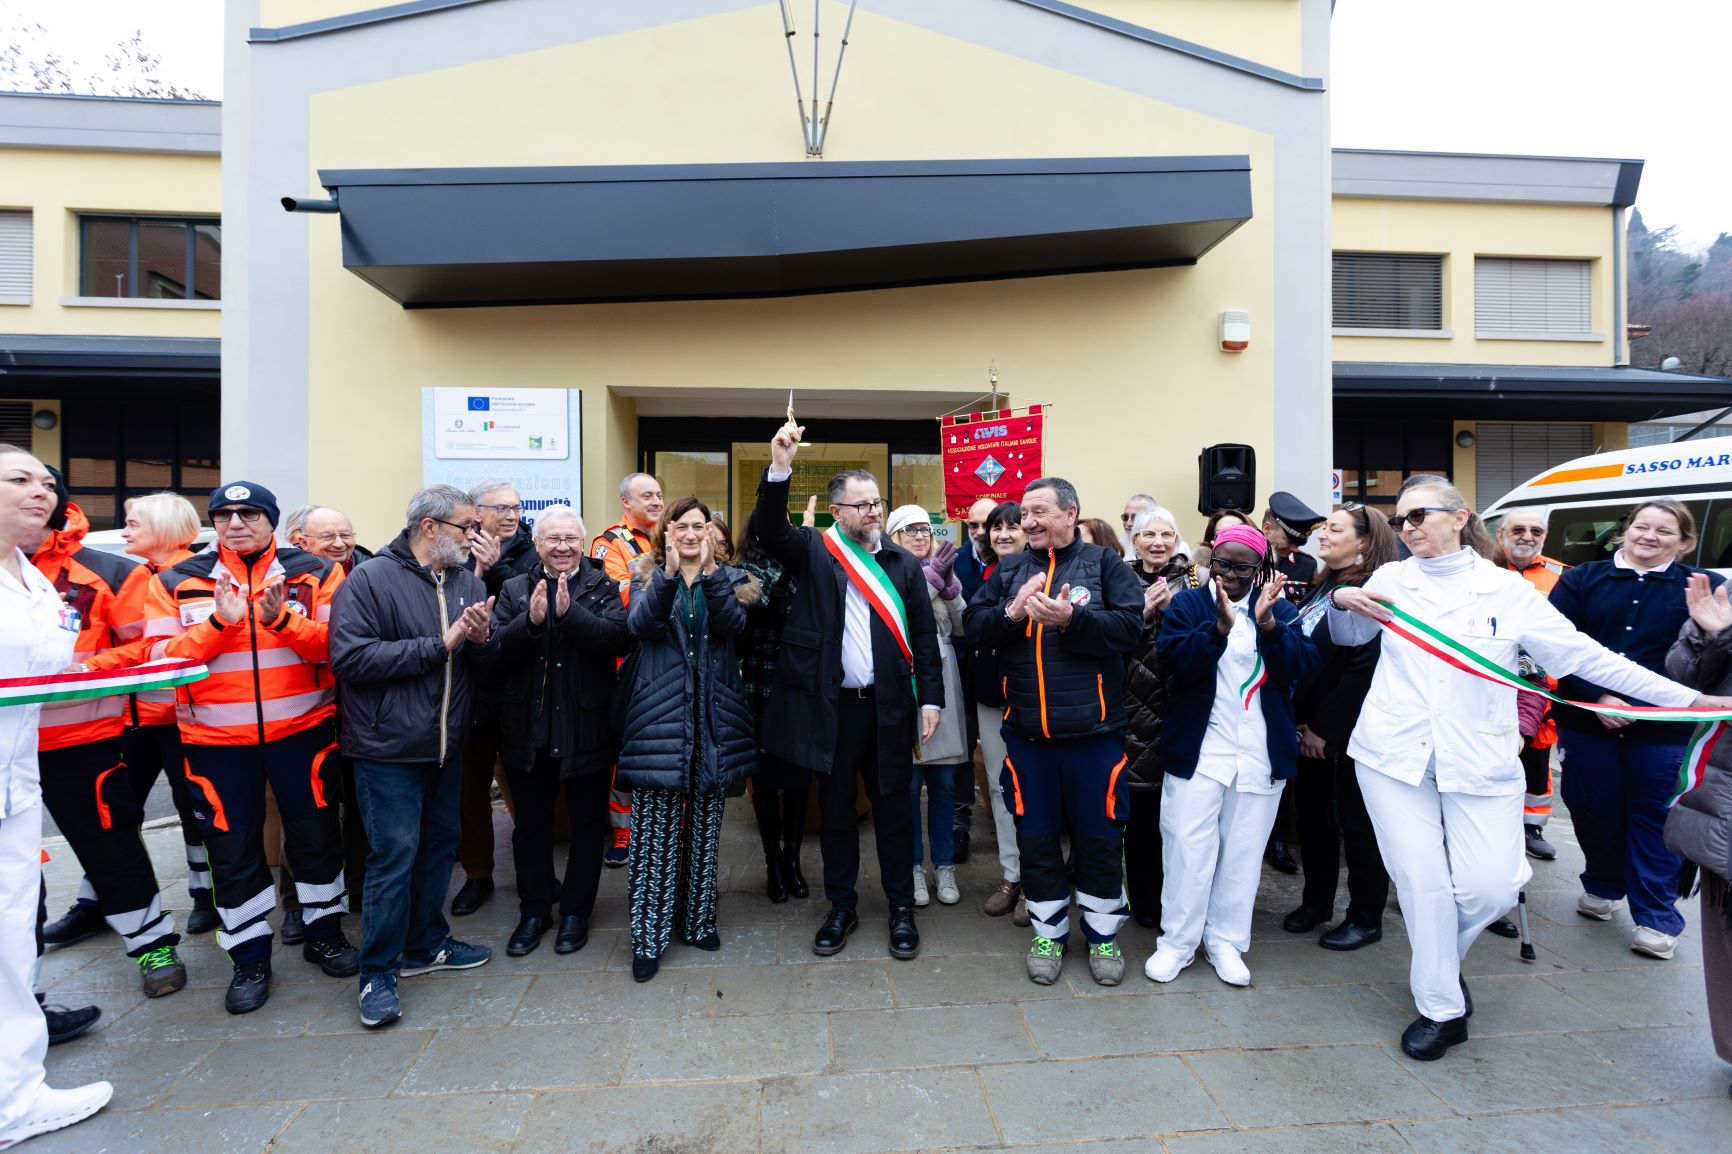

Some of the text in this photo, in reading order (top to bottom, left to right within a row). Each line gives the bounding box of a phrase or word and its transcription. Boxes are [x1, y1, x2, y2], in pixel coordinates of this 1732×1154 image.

[1626, 454, 1731, 474] SASSO MAR
[975, 492, 1008, 500] COMUNALE
[519, 497, 571, 511] omunità
[955, 506, 972, 515] SAS
